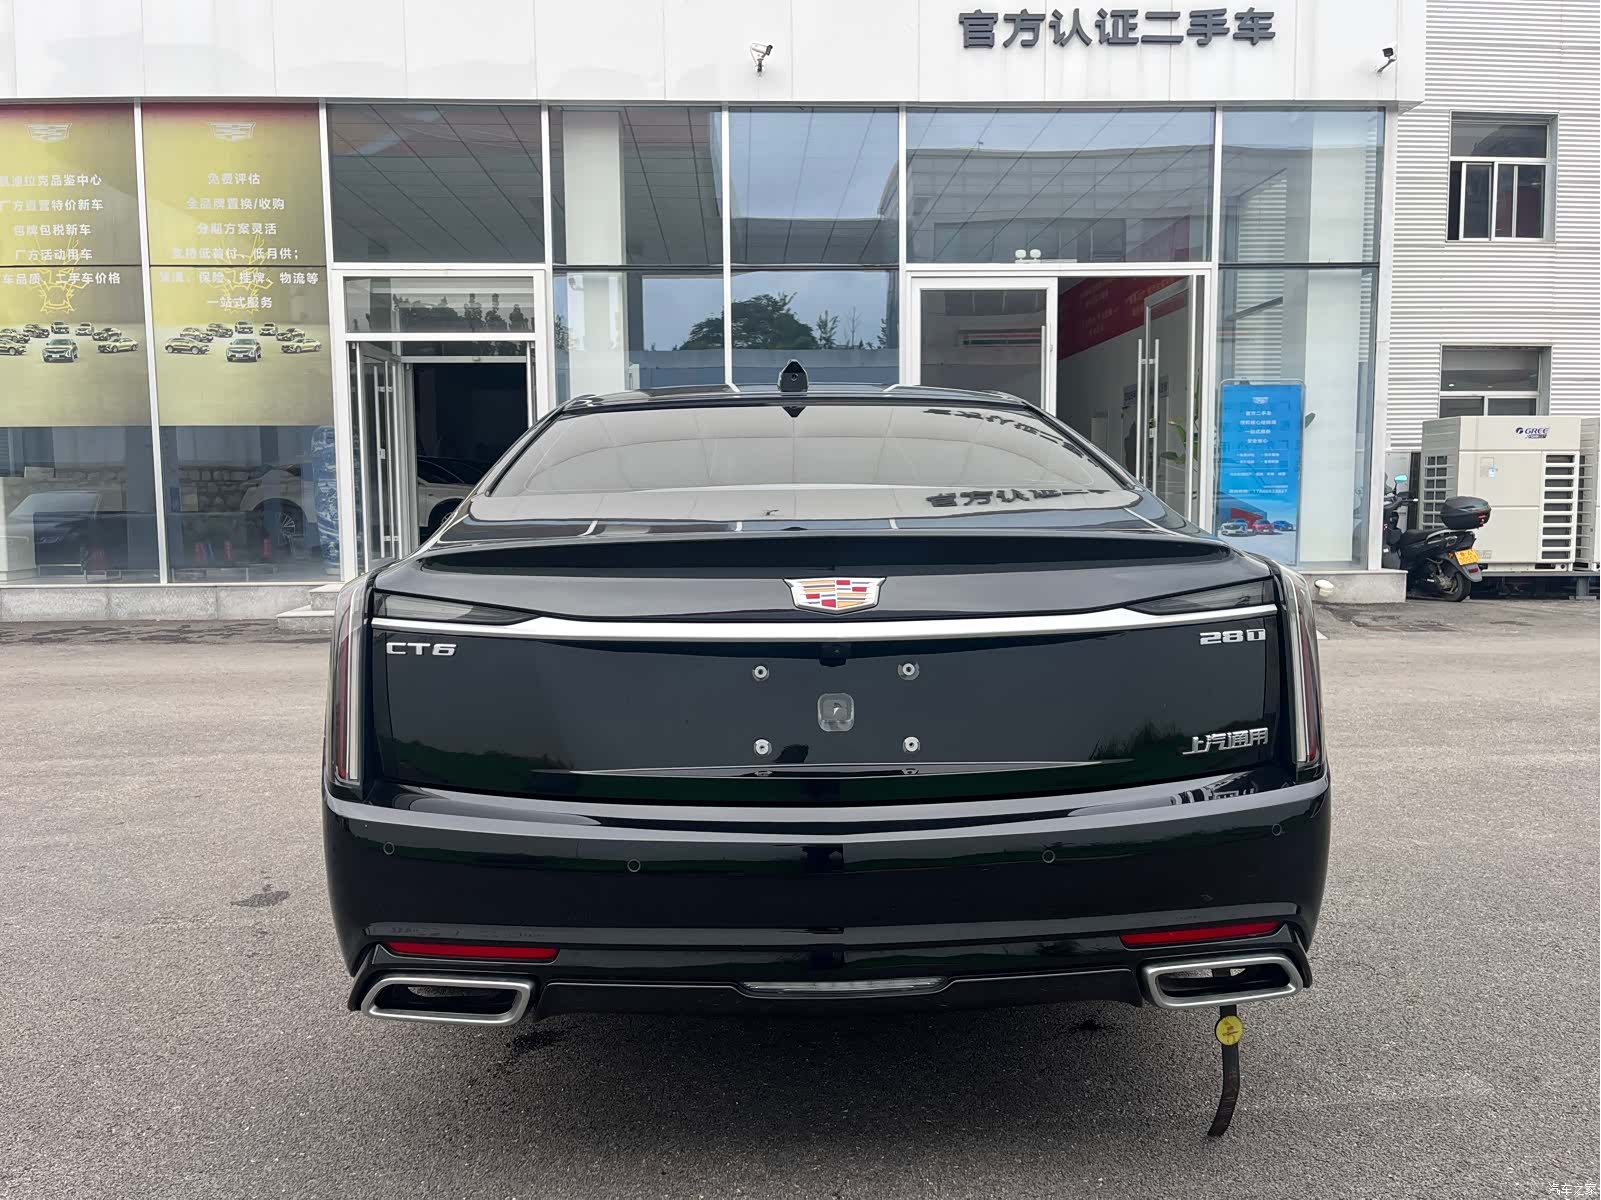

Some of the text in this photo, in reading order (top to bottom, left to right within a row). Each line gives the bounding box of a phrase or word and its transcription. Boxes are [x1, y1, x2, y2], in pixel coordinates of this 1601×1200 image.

[959, 7, 1276, 48] 官方认证二手车
[208, 173, 261, 185] 免费评估
[15, 248, 93, 261] 厂方活动用车
[207, 297, 273, 309] 一站式服务
[386, 642, 457, 656] CT6
[1182, 727, 1268, 755] 上汽通用
